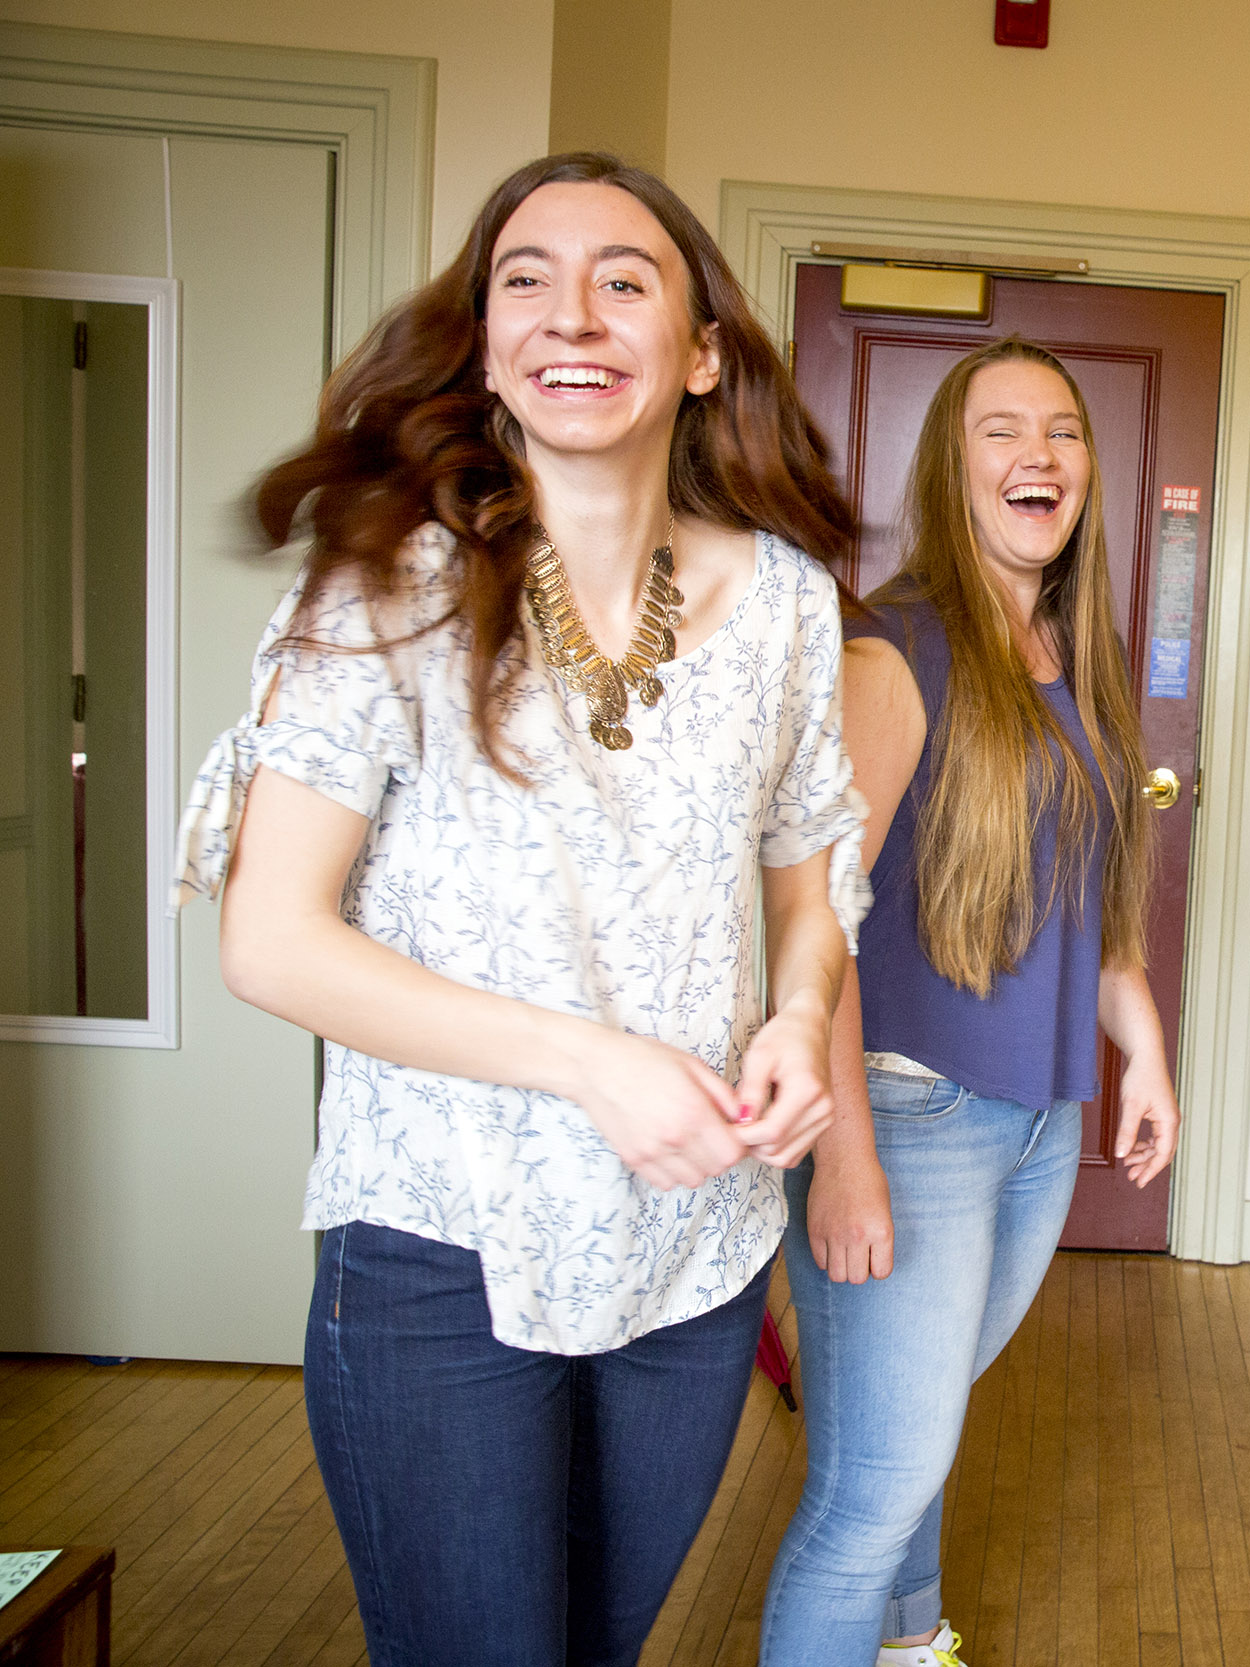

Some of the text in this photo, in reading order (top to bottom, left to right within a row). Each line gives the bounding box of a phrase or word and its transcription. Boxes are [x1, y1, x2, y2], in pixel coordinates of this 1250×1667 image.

[1173, 488, 1189, 500] CASE
[1190, 489, 1199, 500] OF
[1163, 499, 1198, 511] FIRE
[6, 1552, 50, 1586] KEEP
